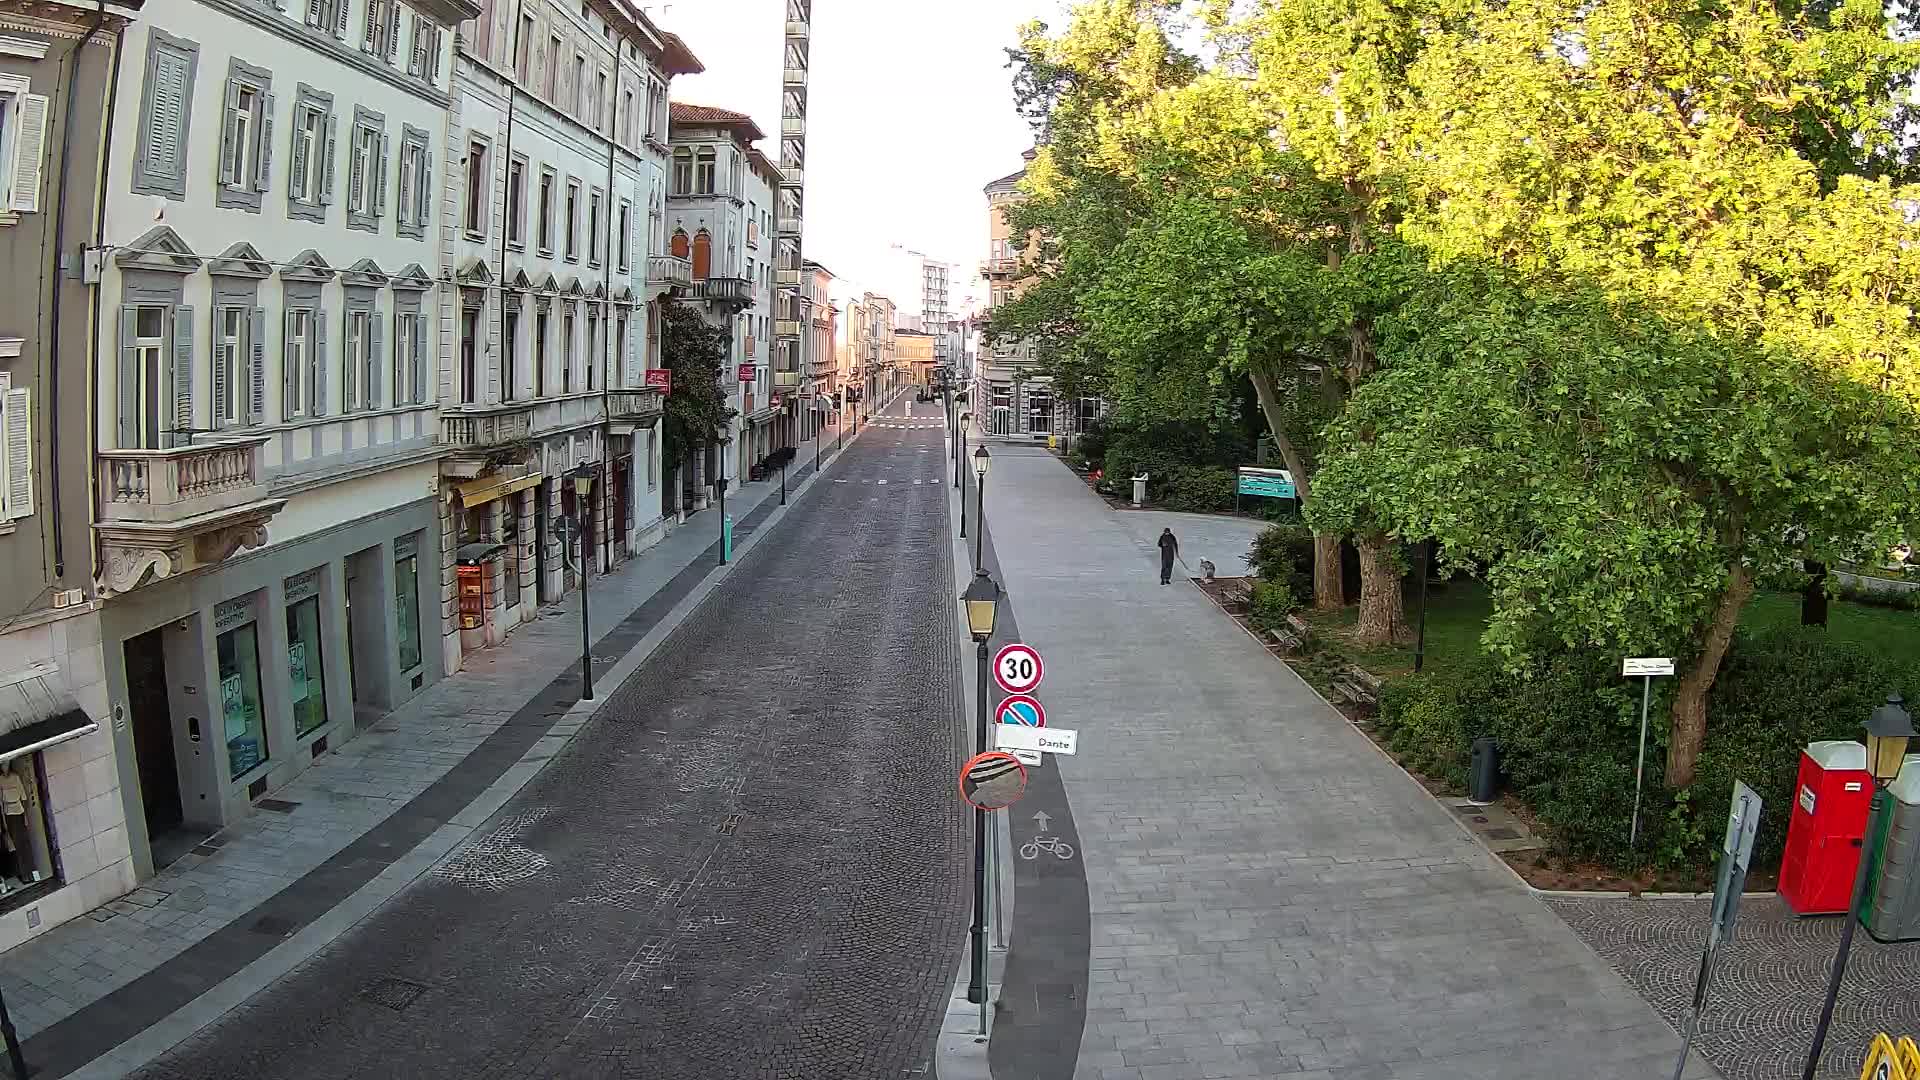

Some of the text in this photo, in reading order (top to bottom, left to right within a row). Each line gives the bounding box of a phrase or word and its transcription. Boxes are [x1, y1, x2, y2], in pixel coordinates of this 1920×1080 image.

[1006, 658, 1032, 679] 30
[222, 677, 241, 700] 130
[1038, 737, 1070, 749] Dante
